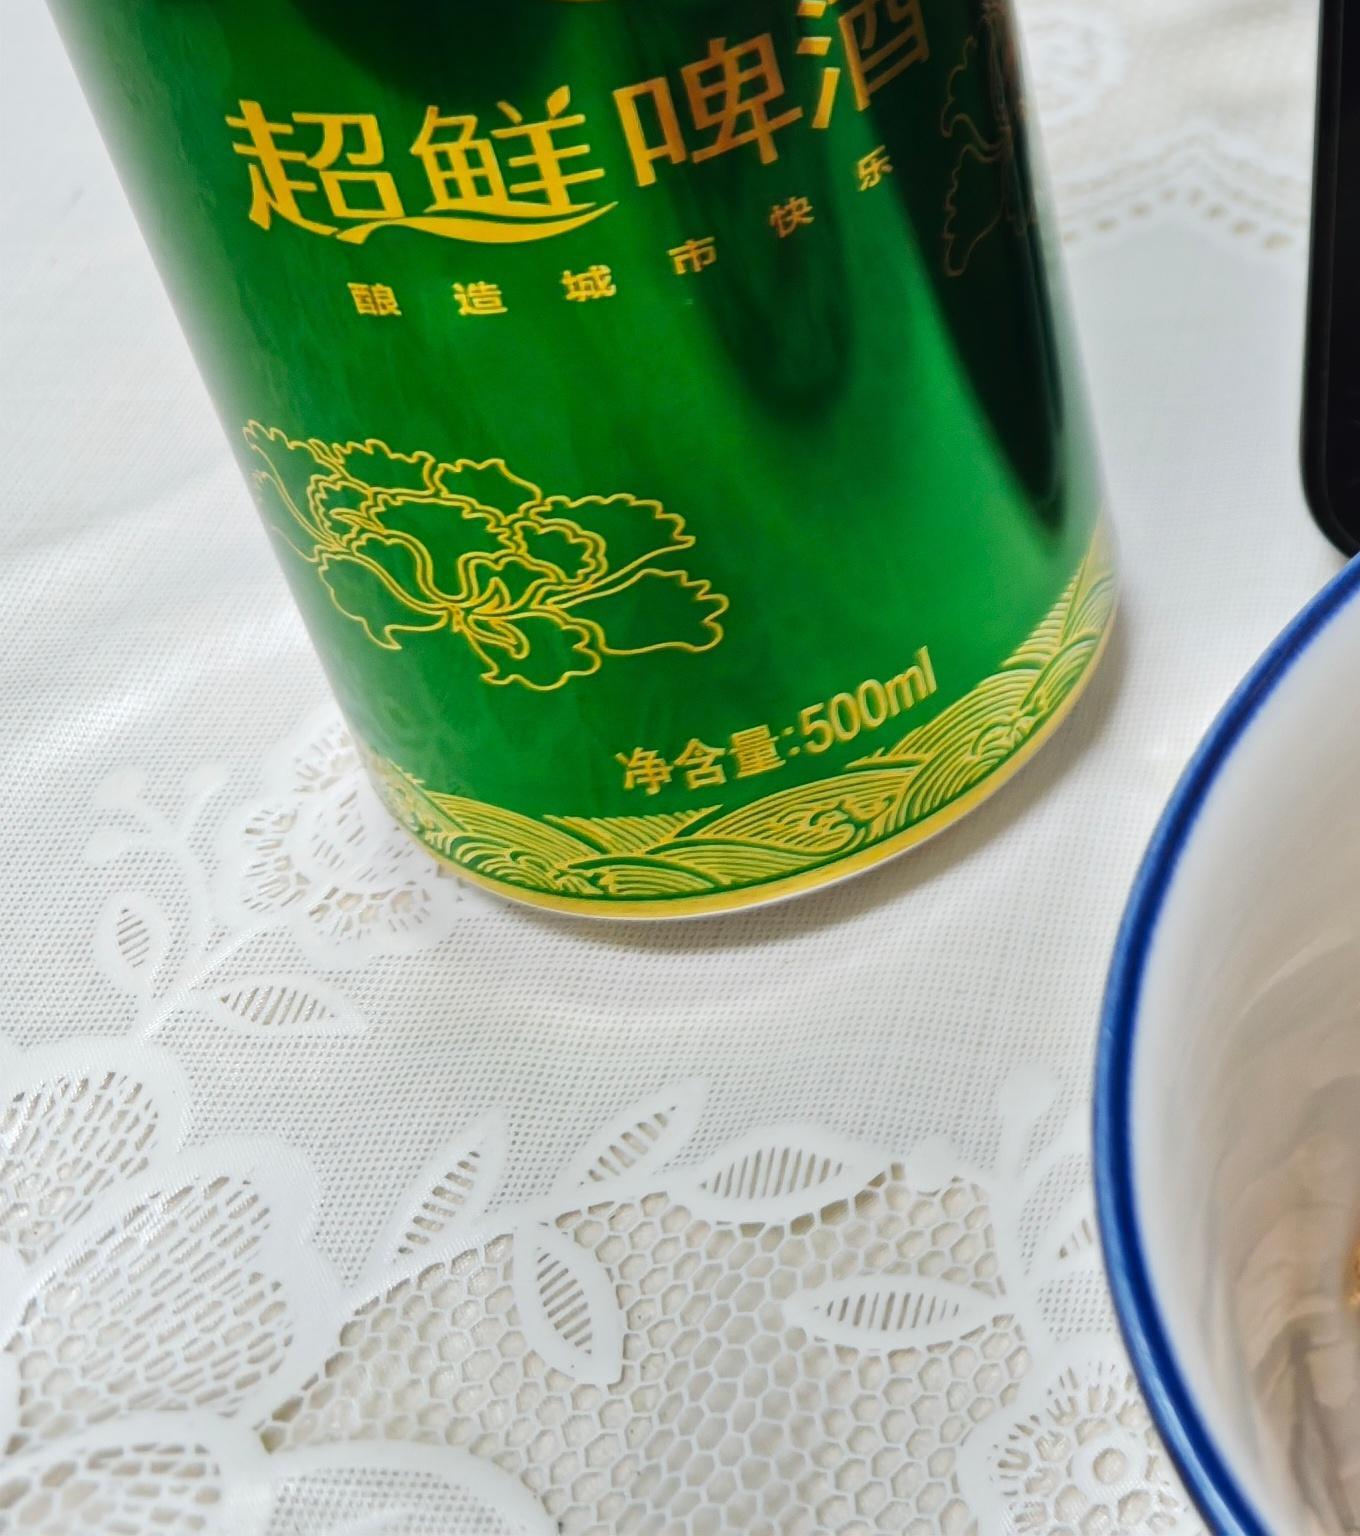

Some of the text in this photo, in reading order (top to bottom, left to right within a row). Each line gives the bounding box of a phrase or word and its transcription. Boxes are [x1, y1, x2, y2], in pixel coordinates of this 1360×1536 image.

[346, 145, 895, 318] 酿造城市快乐
